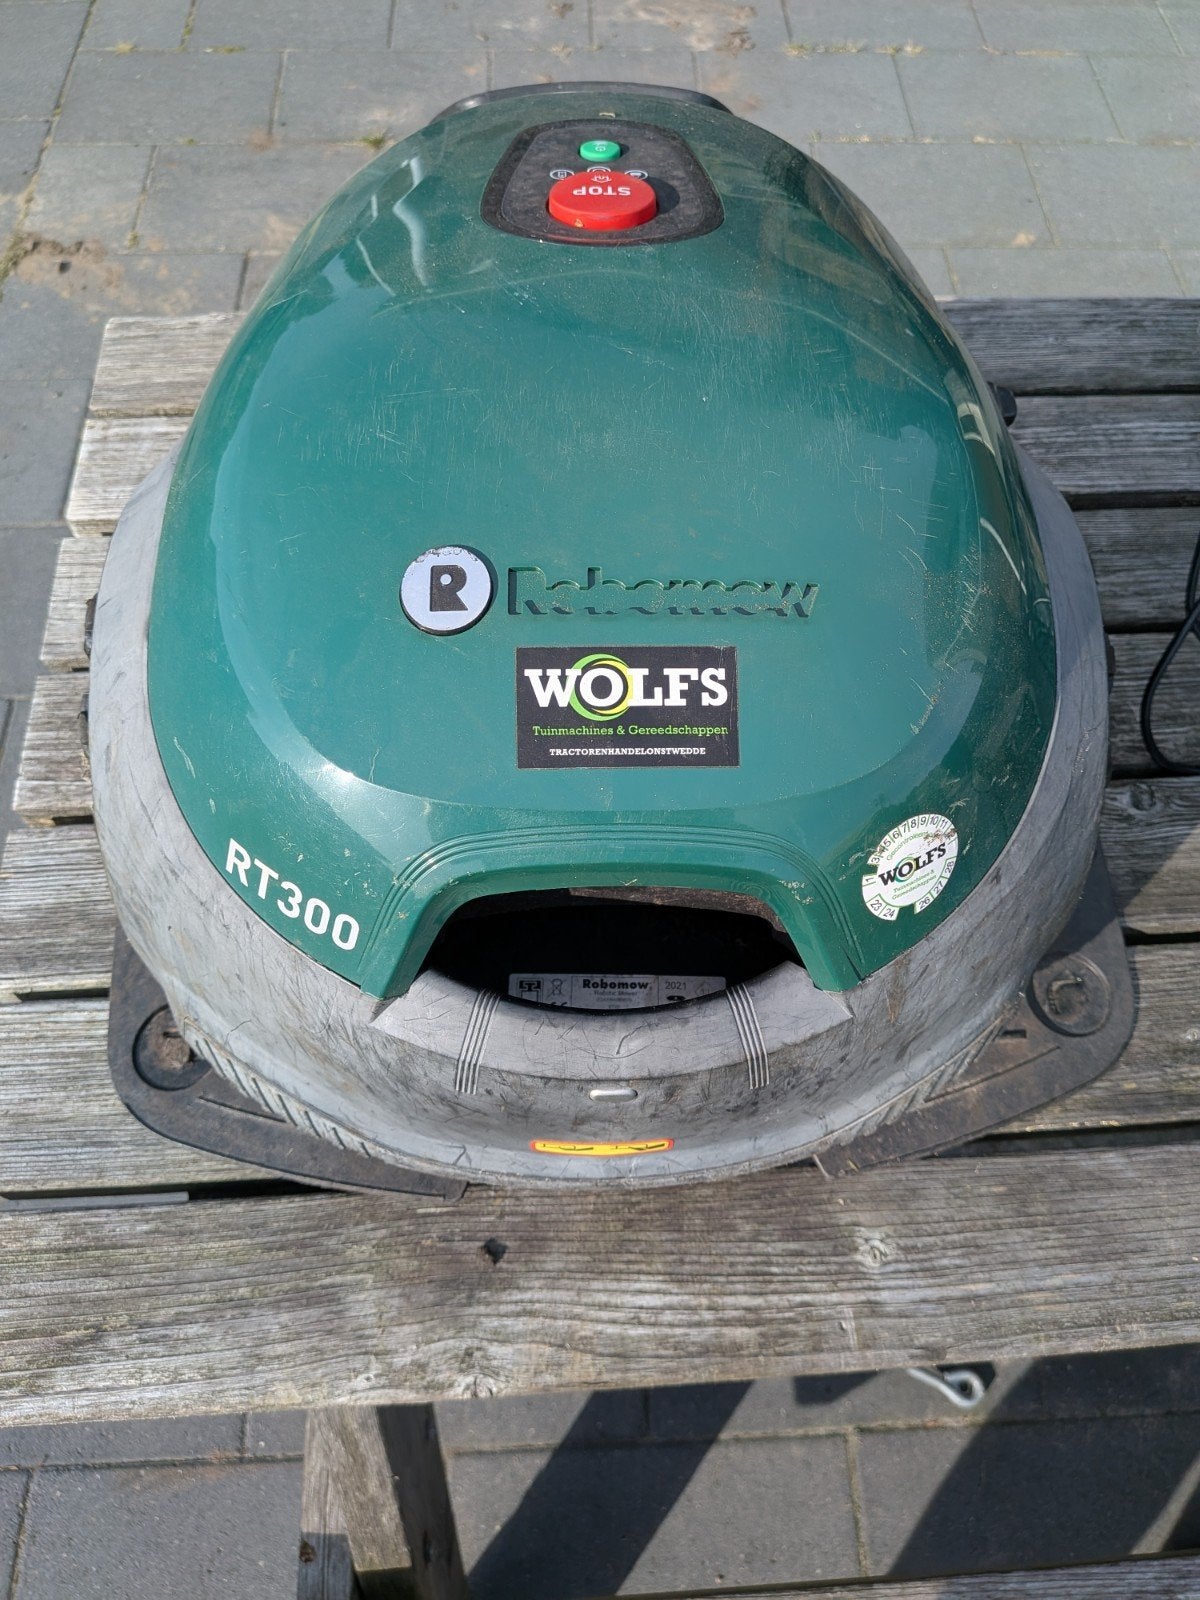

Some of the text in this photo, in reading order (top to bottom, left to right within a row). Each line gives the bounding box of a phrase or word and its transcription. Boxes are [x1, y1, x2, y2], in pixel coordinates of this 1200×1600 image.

[573, 186, 631, 196] STOP
[429, 564, 468, 612] R
[507, 566, 820, 618] Robomow
[524, 667, 728, 708] WOLFS
[532, 725, 728, 738] Tuinmachines & Gereedschappen
[549, 748, 706, 756] TRACTORENHANDELONSTWEDDE
[878, 842, 947, 886] WOLFS
[225, 837, 360, 951] RT300
[870, 899, 882, 911] 23
[918, 896, 931, 909] 26
[883, 908, 895, 918] 24
[582, 979, 687, 990] Robomow 2021
